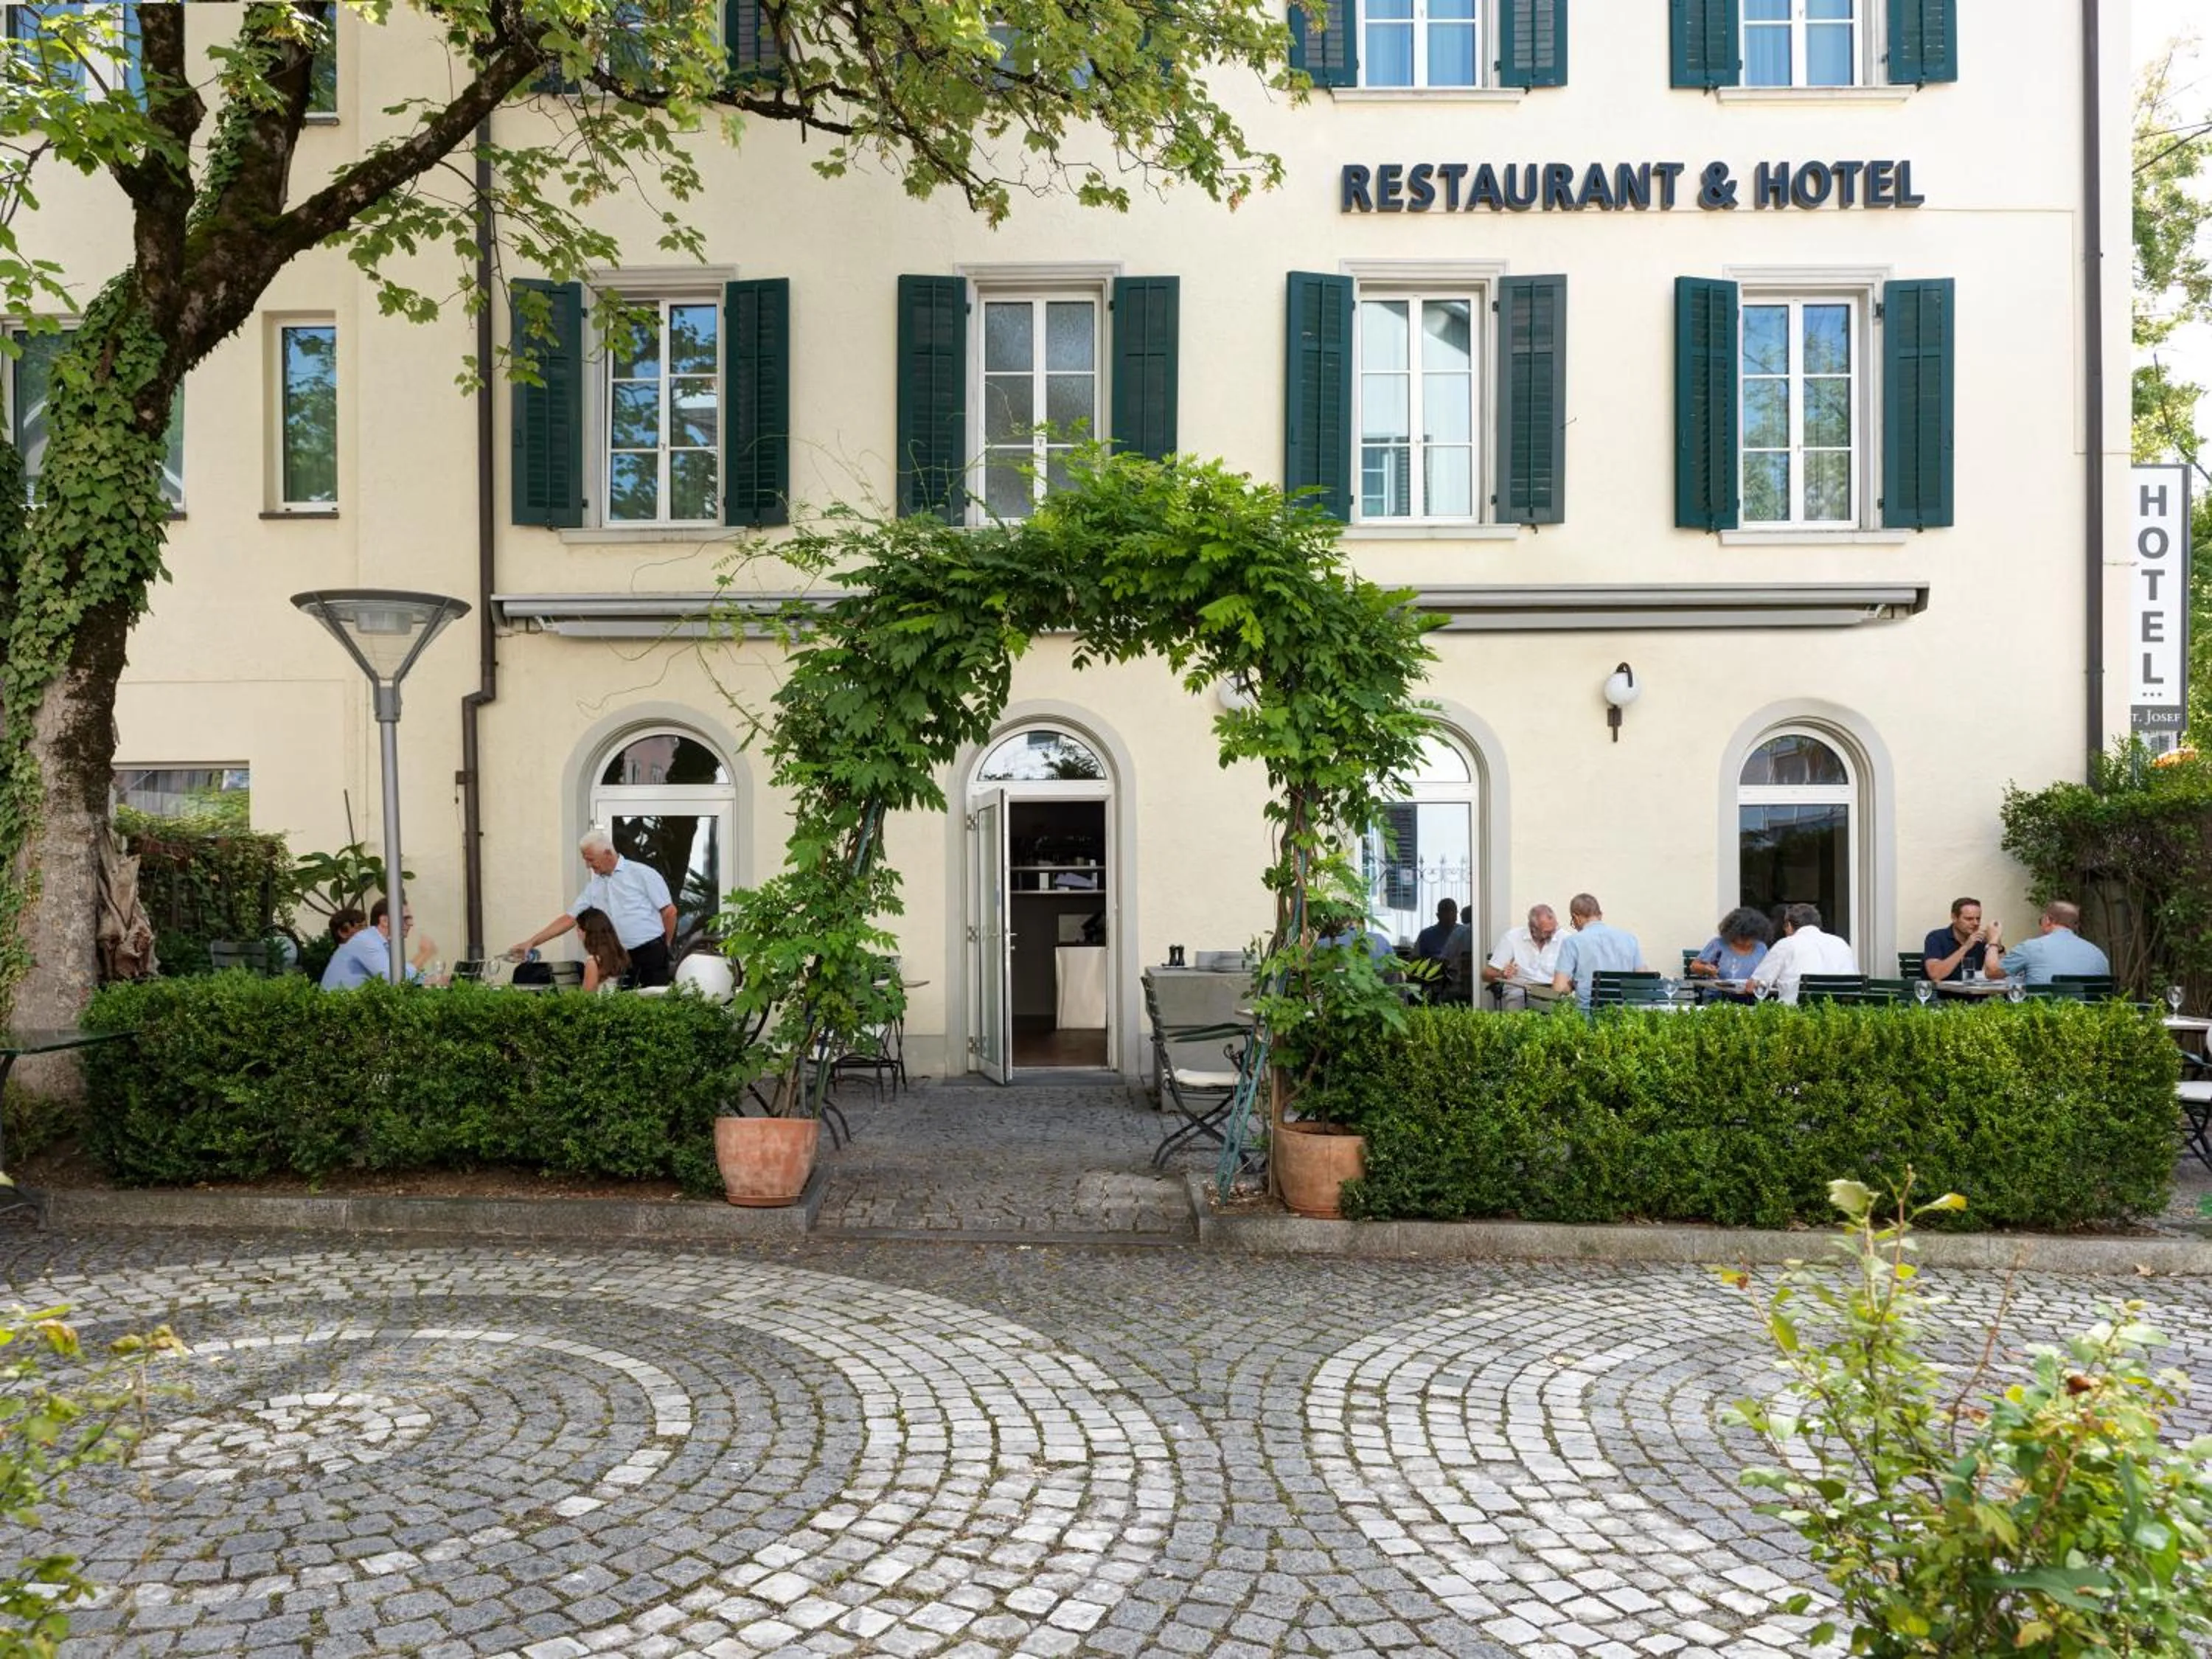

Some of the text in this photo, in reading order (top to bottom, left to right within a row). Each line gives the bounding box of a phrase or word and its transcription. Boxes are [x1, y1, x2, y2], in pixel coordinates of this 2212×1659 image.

[1340, 160, 1925, 213] RESTAURANT & HOTEL
[2138, 484, 2169, 684] HOTEL
